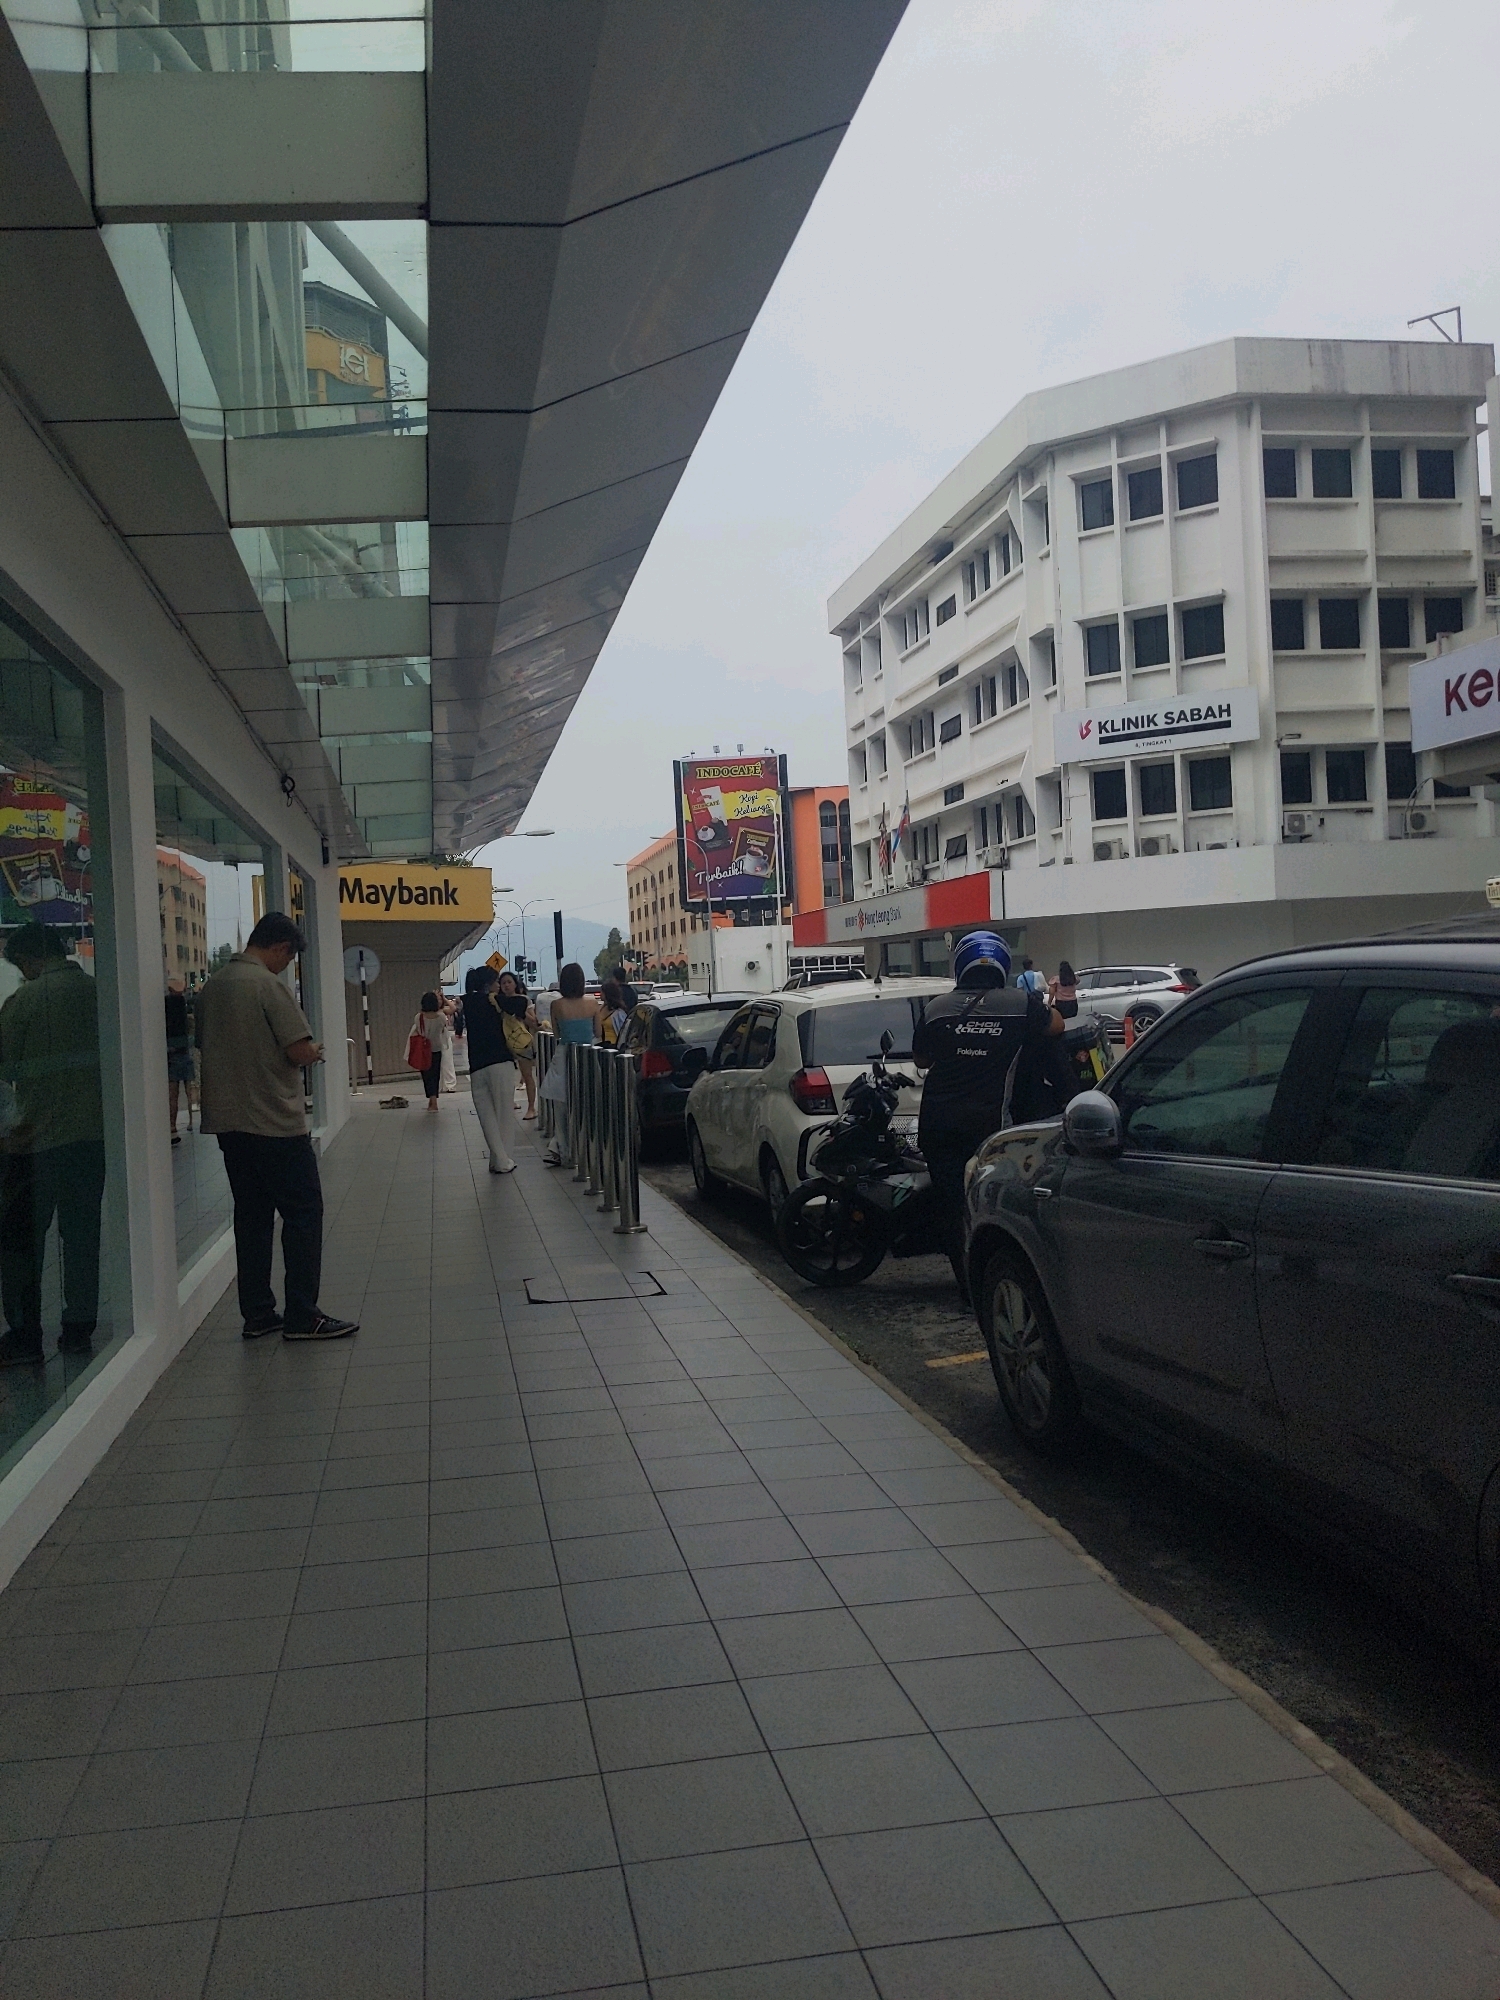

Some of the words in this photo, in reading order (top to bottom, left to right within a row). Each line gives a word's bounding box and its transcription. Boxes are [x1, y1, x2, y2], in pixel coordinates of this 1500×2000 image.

[1445, 666, 1500, 717] Ke
[1098, 713, 1159, 735] KLINIK
[1164, 703, 1232, 726] SABAH
[696, 762, 762, 779] INDOCAFÉ
[733, 803, 771, 817] Keluarga
[739, 793, 759, 804] Kopi
[694, 860, 743, 885] Terbaik!
[339, 876, 460, 912] Maybank
